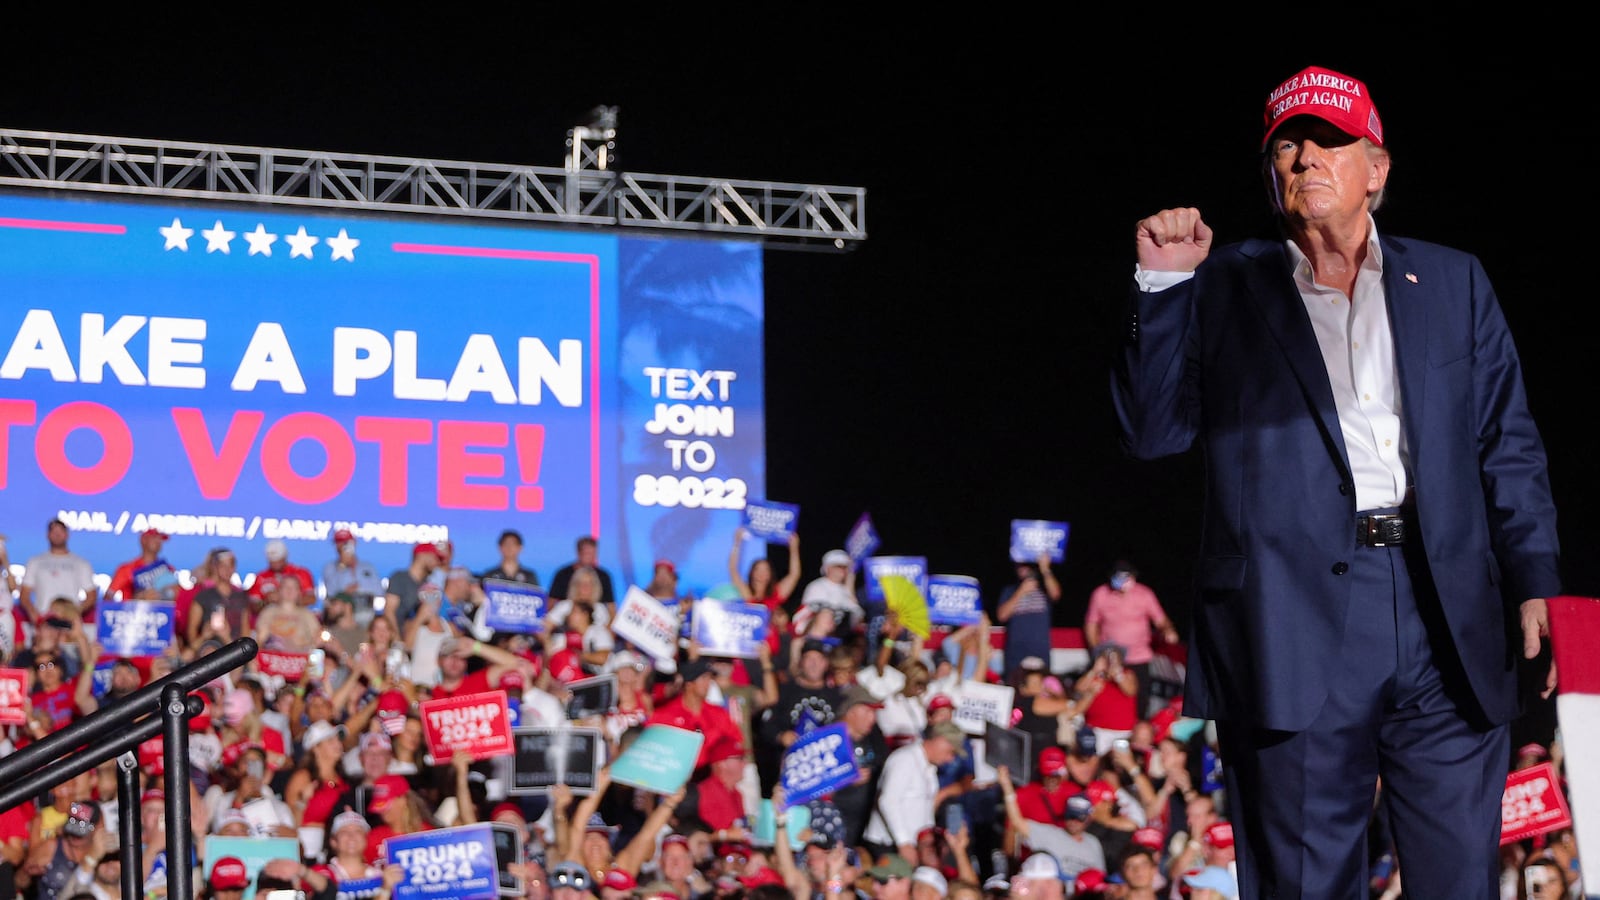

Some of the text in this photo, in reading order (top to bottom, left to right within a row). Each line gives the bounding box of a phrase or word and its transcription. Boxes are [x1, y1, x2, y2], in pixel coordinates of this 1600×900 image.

[1268, 73, 1361, 105] MAKE AMERICA
[1273, 92, 1353, 119] GREAT AGAIN
[231, 322, 307, 394] A
[333, 326, 582, 407] PLAN
[643, 367, 737, 402] TEXT
[644, 403, 735, 437] JOIN
[171, 408, 545, 512] VOTE!
[664, 440, 716, 473] TO
[633, 474, 747, 510] 88022
[58, 510, 113, 532] MAIL
[114, 511, 130, 535] /
[246, 516, 261, 540] /
[263, 518, 331, 541] EARLY
[489, 590, 543, 608] TRUMP
[929, 584, 980, 601] TRUMP
[103, 610, 168, 628] TRUMP
[708, 610, 763, 628] RUMP
[428, 703, 500, 730] TRUMP
[441, 720, 493, 743] 2024
[521, 735, 587, 752] NER
[785, 752, 838, 788] 2024
[395, 841, 483, 869] TRUMP
[410, 860, 474, 885] 2024
